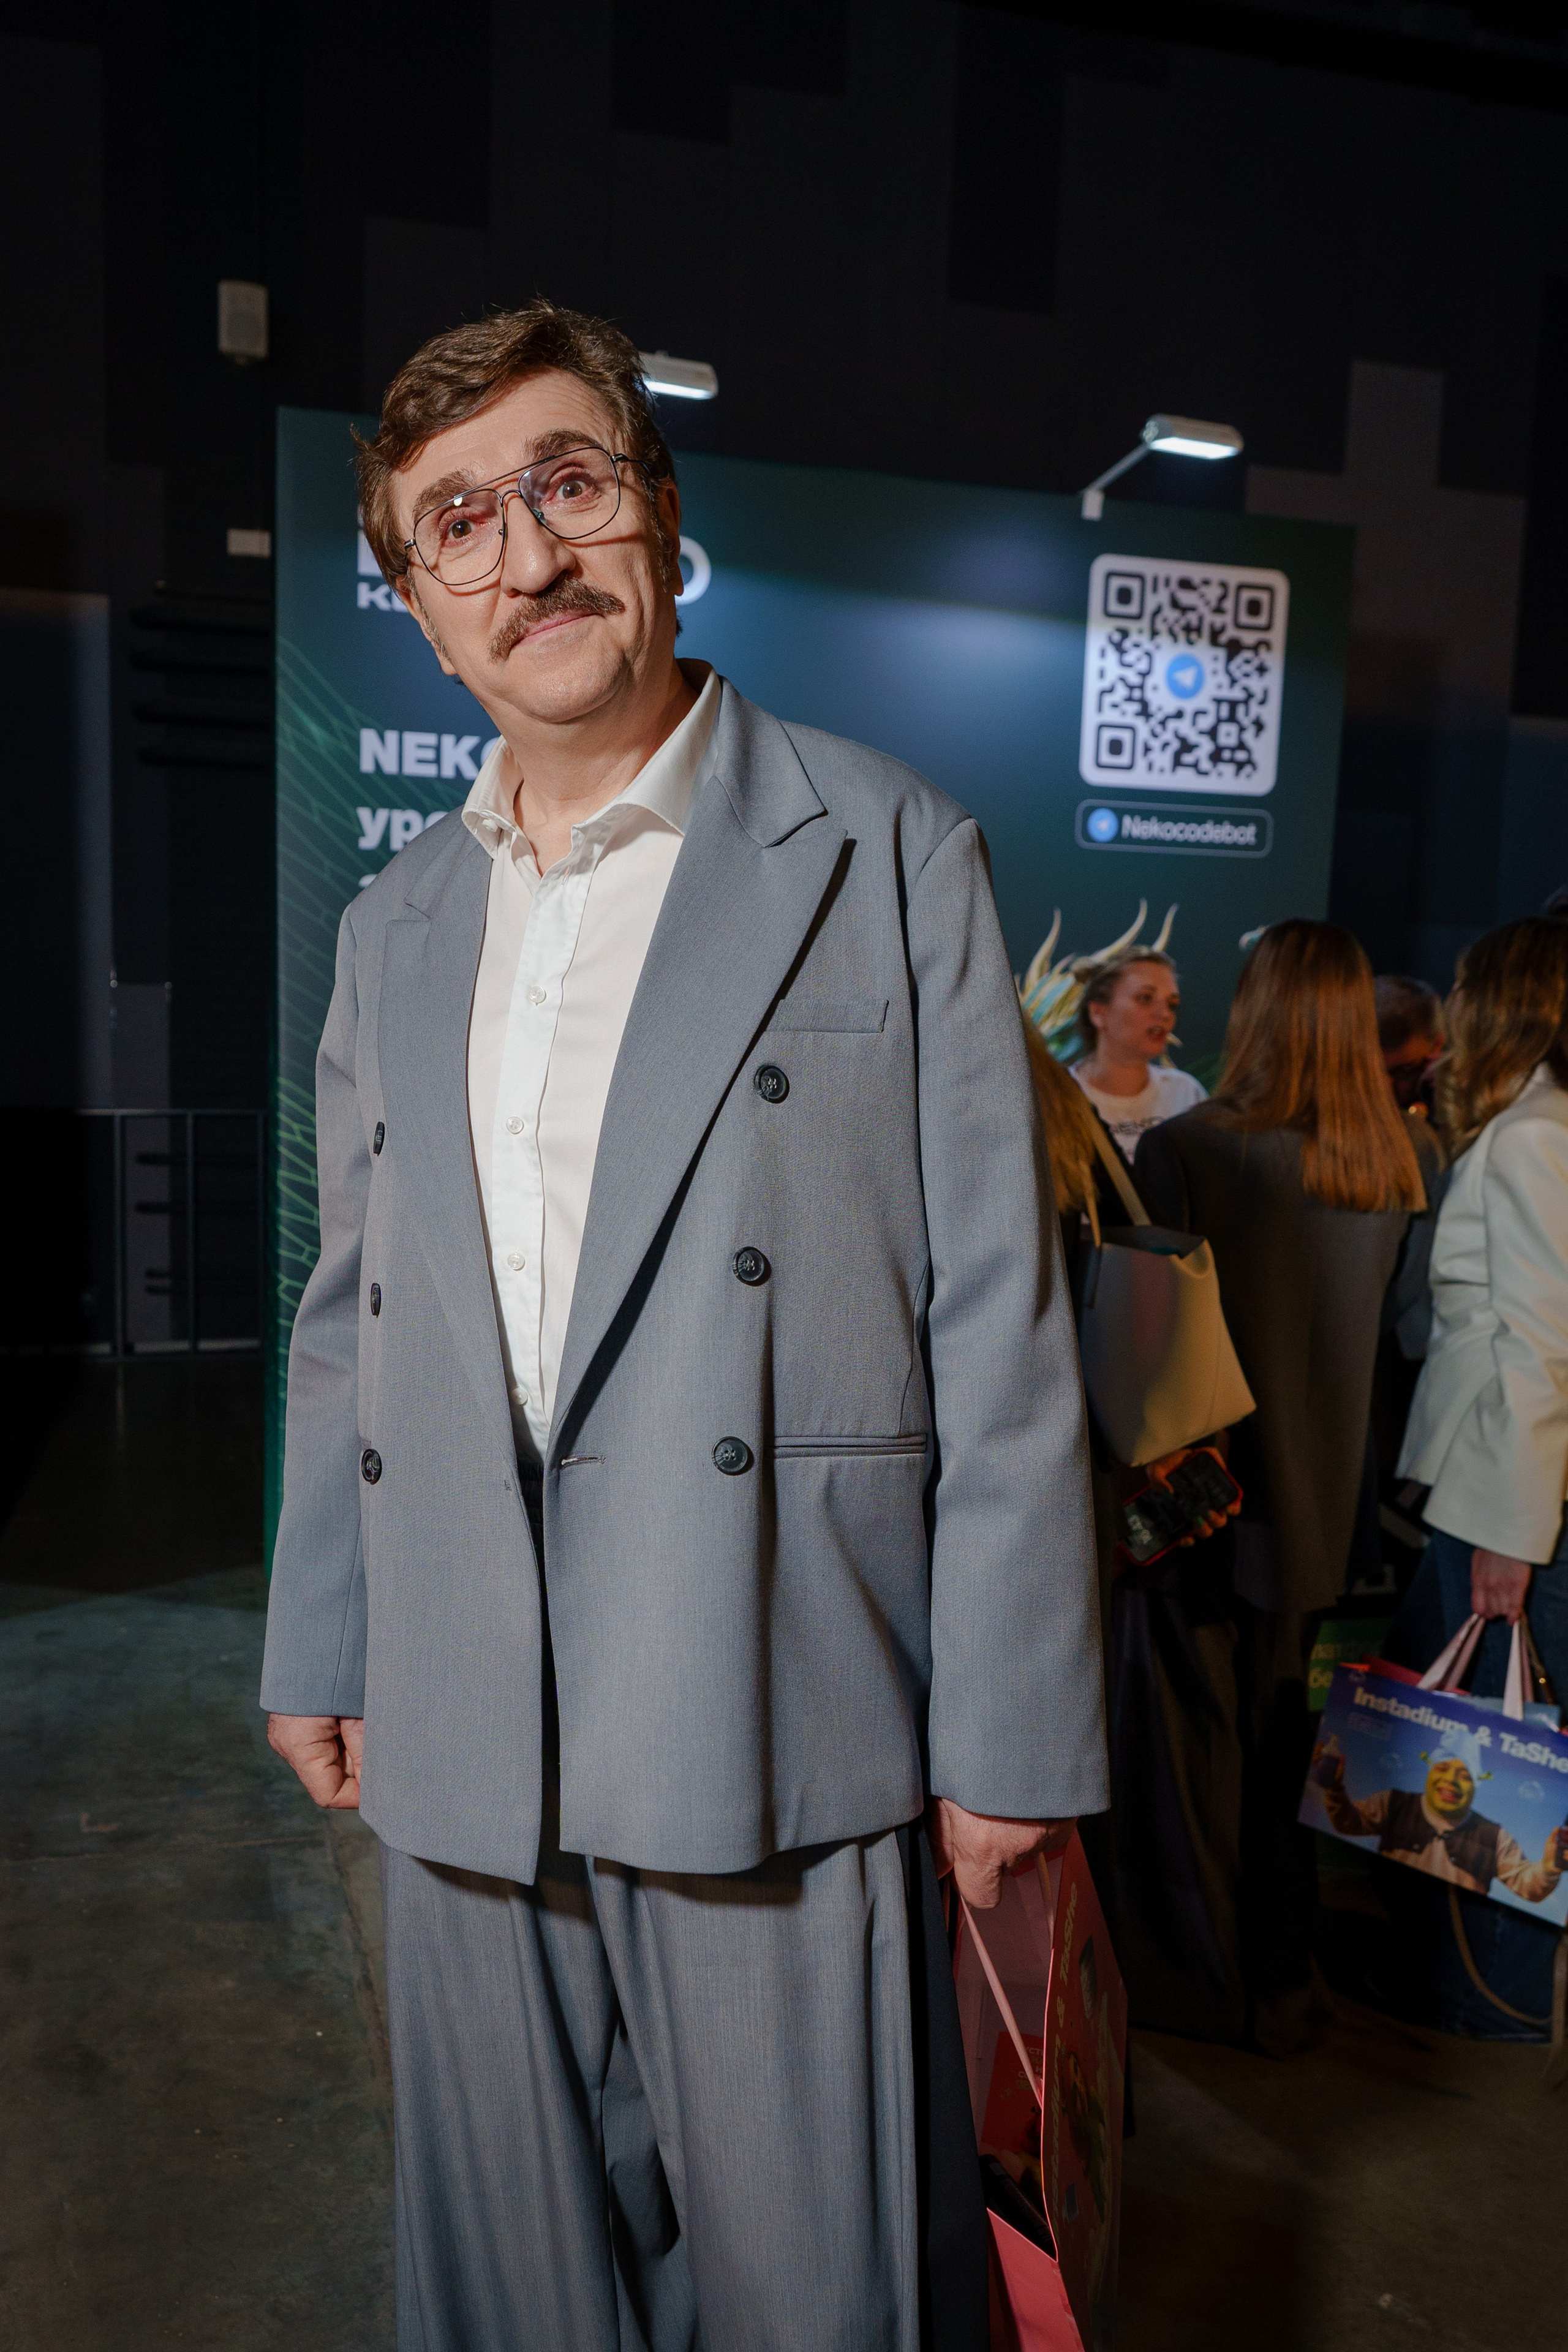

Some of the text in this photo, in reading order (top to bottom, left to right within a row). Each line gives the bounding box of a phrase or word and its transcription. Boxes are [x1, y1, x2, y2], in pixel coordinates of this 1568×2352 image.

[360, 727, 501, 780] NEK
[1121, 814, 1257, 846] Nekocodebot
[1474, 1725, 1493, 1747] &
